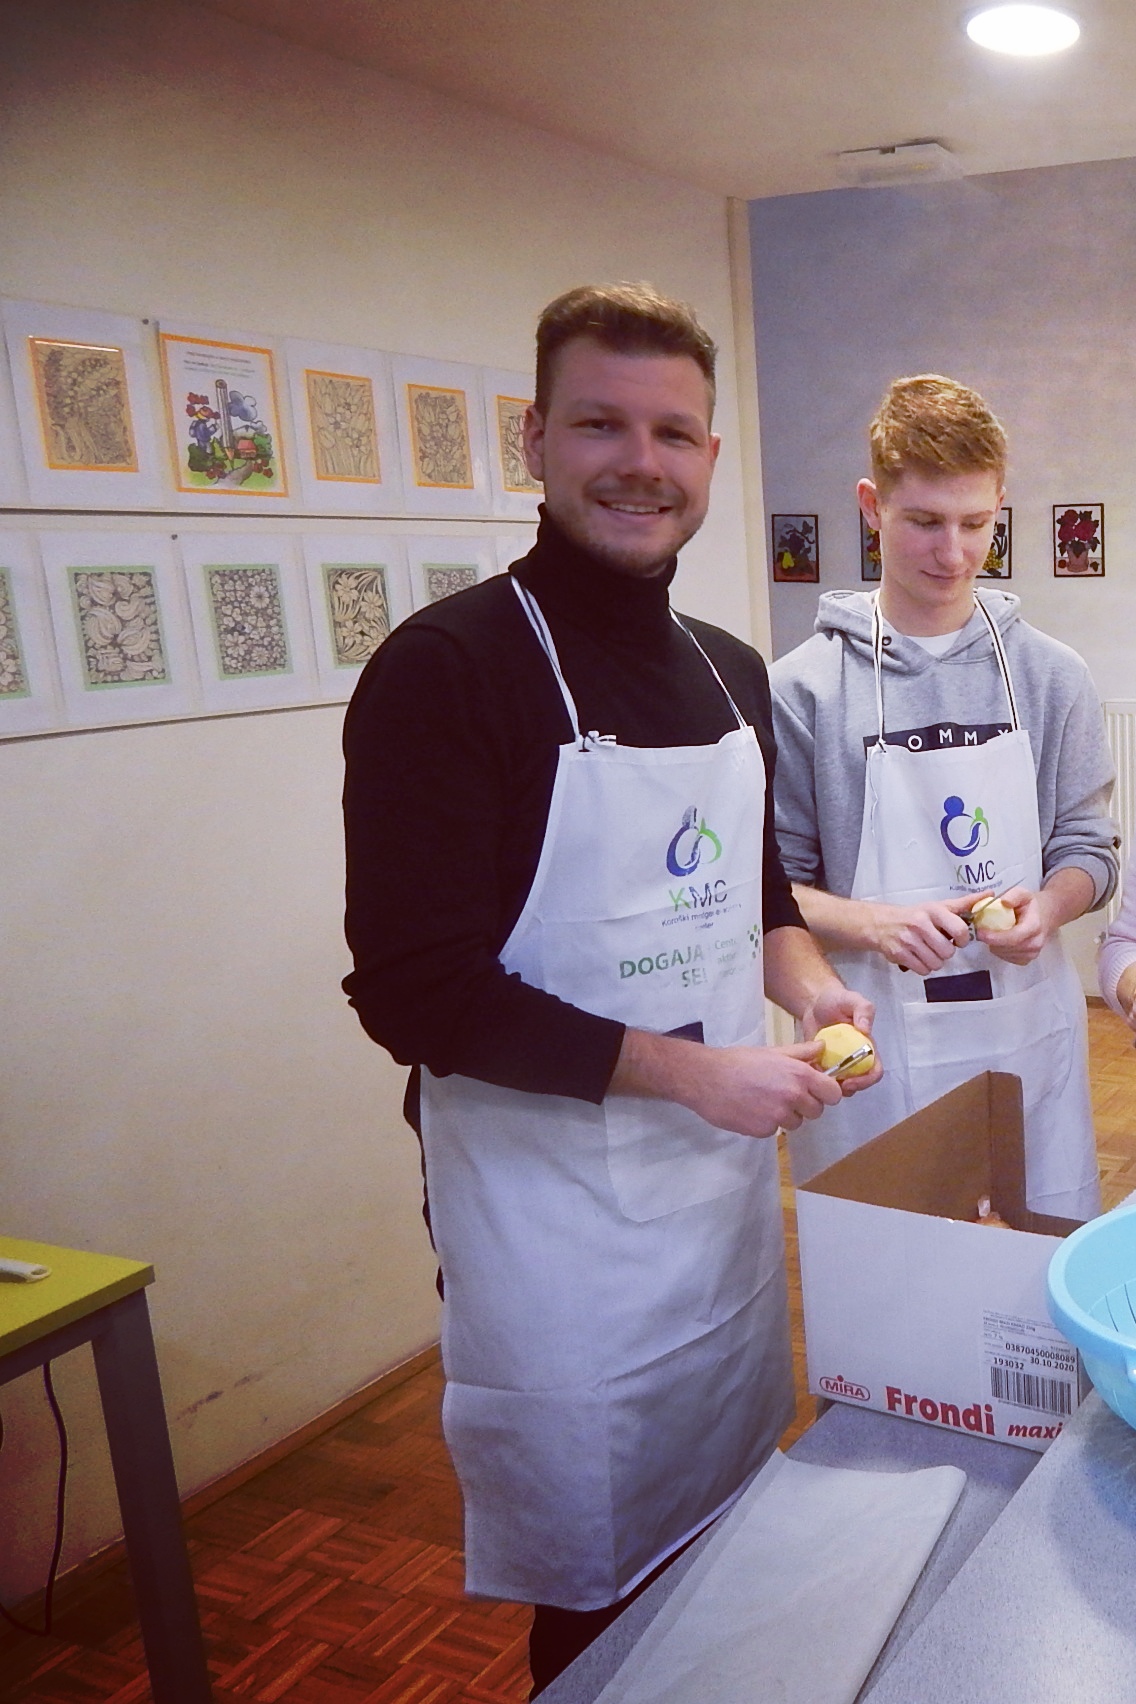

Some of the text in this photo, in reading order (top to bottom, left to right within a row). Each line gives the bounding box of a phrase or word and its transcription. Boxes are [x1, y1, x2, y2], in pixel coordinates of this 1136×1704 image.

[954, 859, 996, 885] KMC
[668, 879, 728, 912] KMC
[619, 944, 705, 980] DOGAJA
[993, 1357, 1025, 1371] 193032
[885, 1385, 996, 1436] Frondi
[1007, 1421, 1063, 1439] maxi
